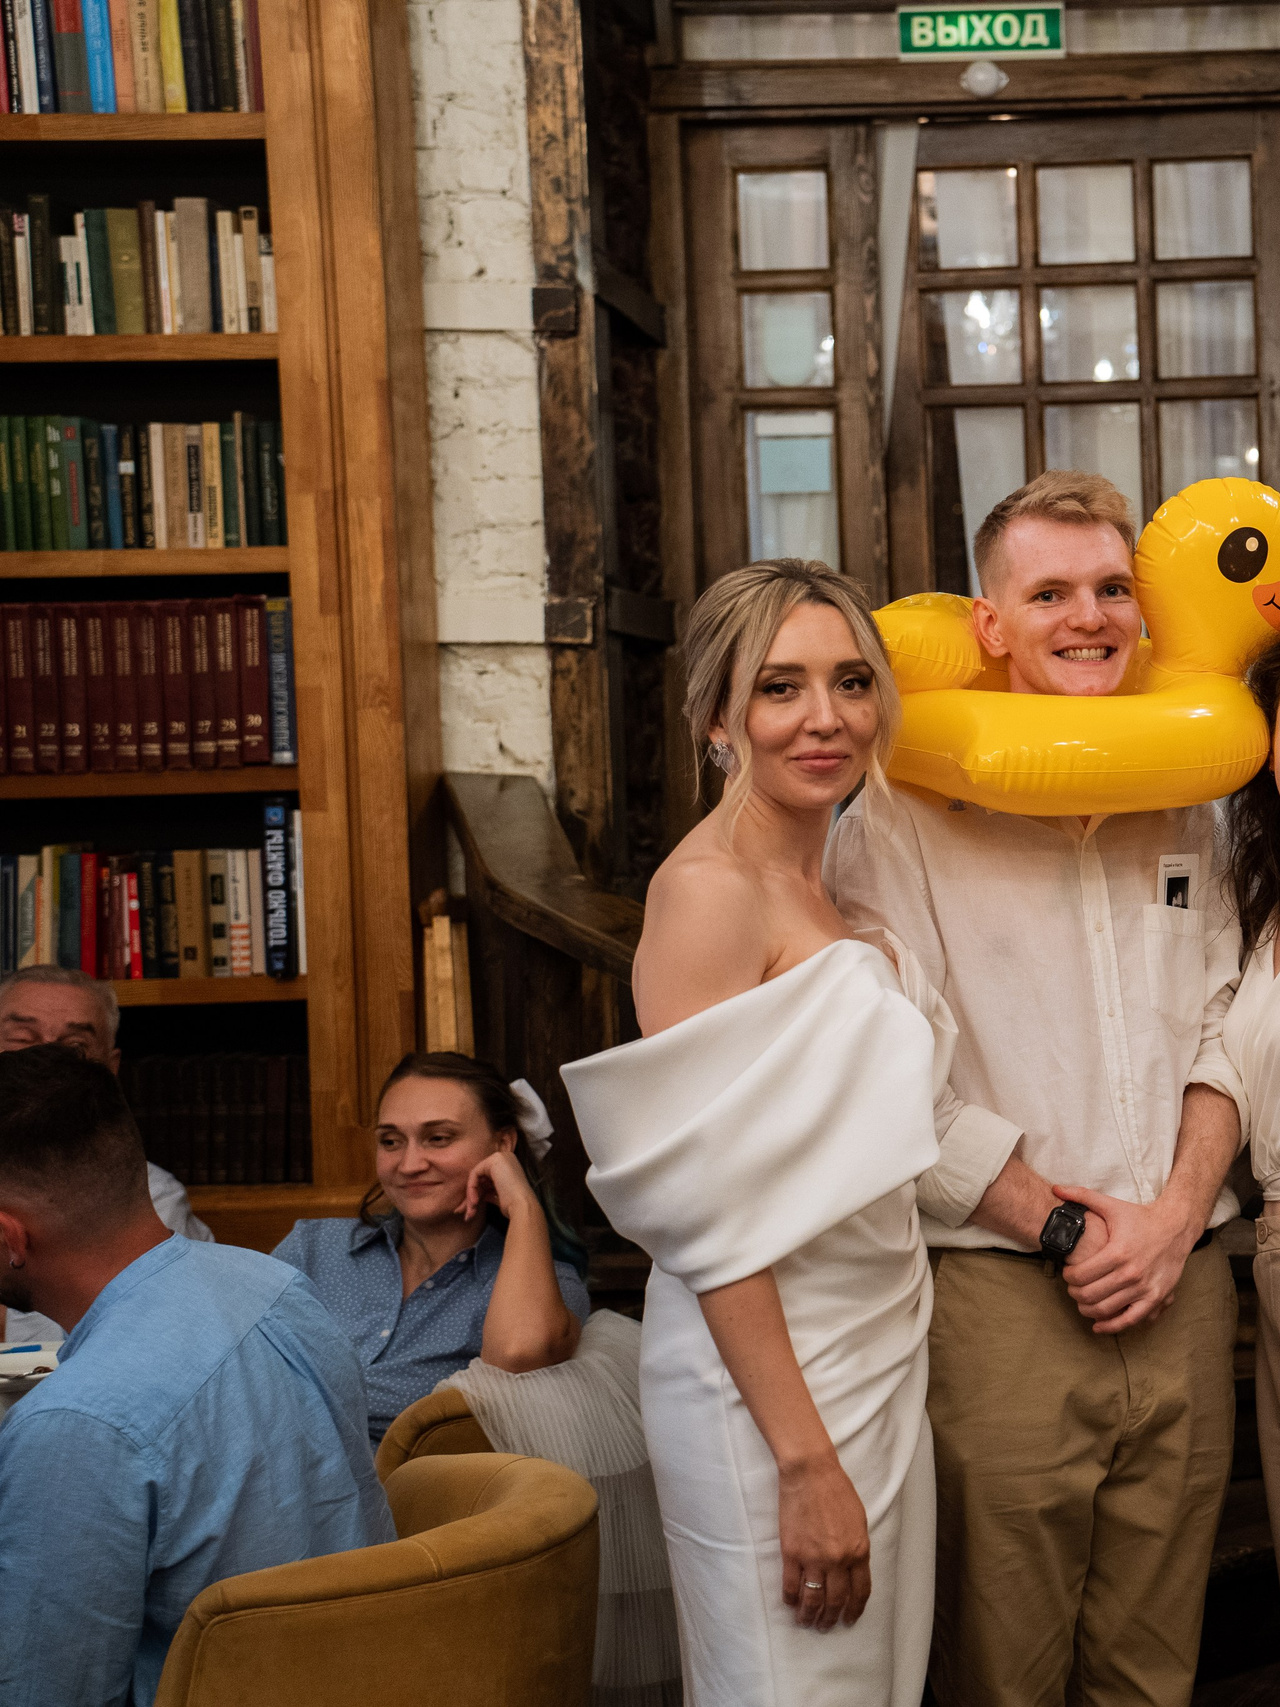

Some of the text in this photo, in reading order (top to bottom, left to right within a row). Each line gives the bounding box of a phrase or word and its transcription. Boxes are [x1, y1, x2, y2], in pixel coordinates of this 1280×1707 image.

[910, 13, 1050, 48] ВЫХОД
[265, 829, 285, 887] ФАКТЫ
[268, 889, 287, 947] ТОЛЬКО
